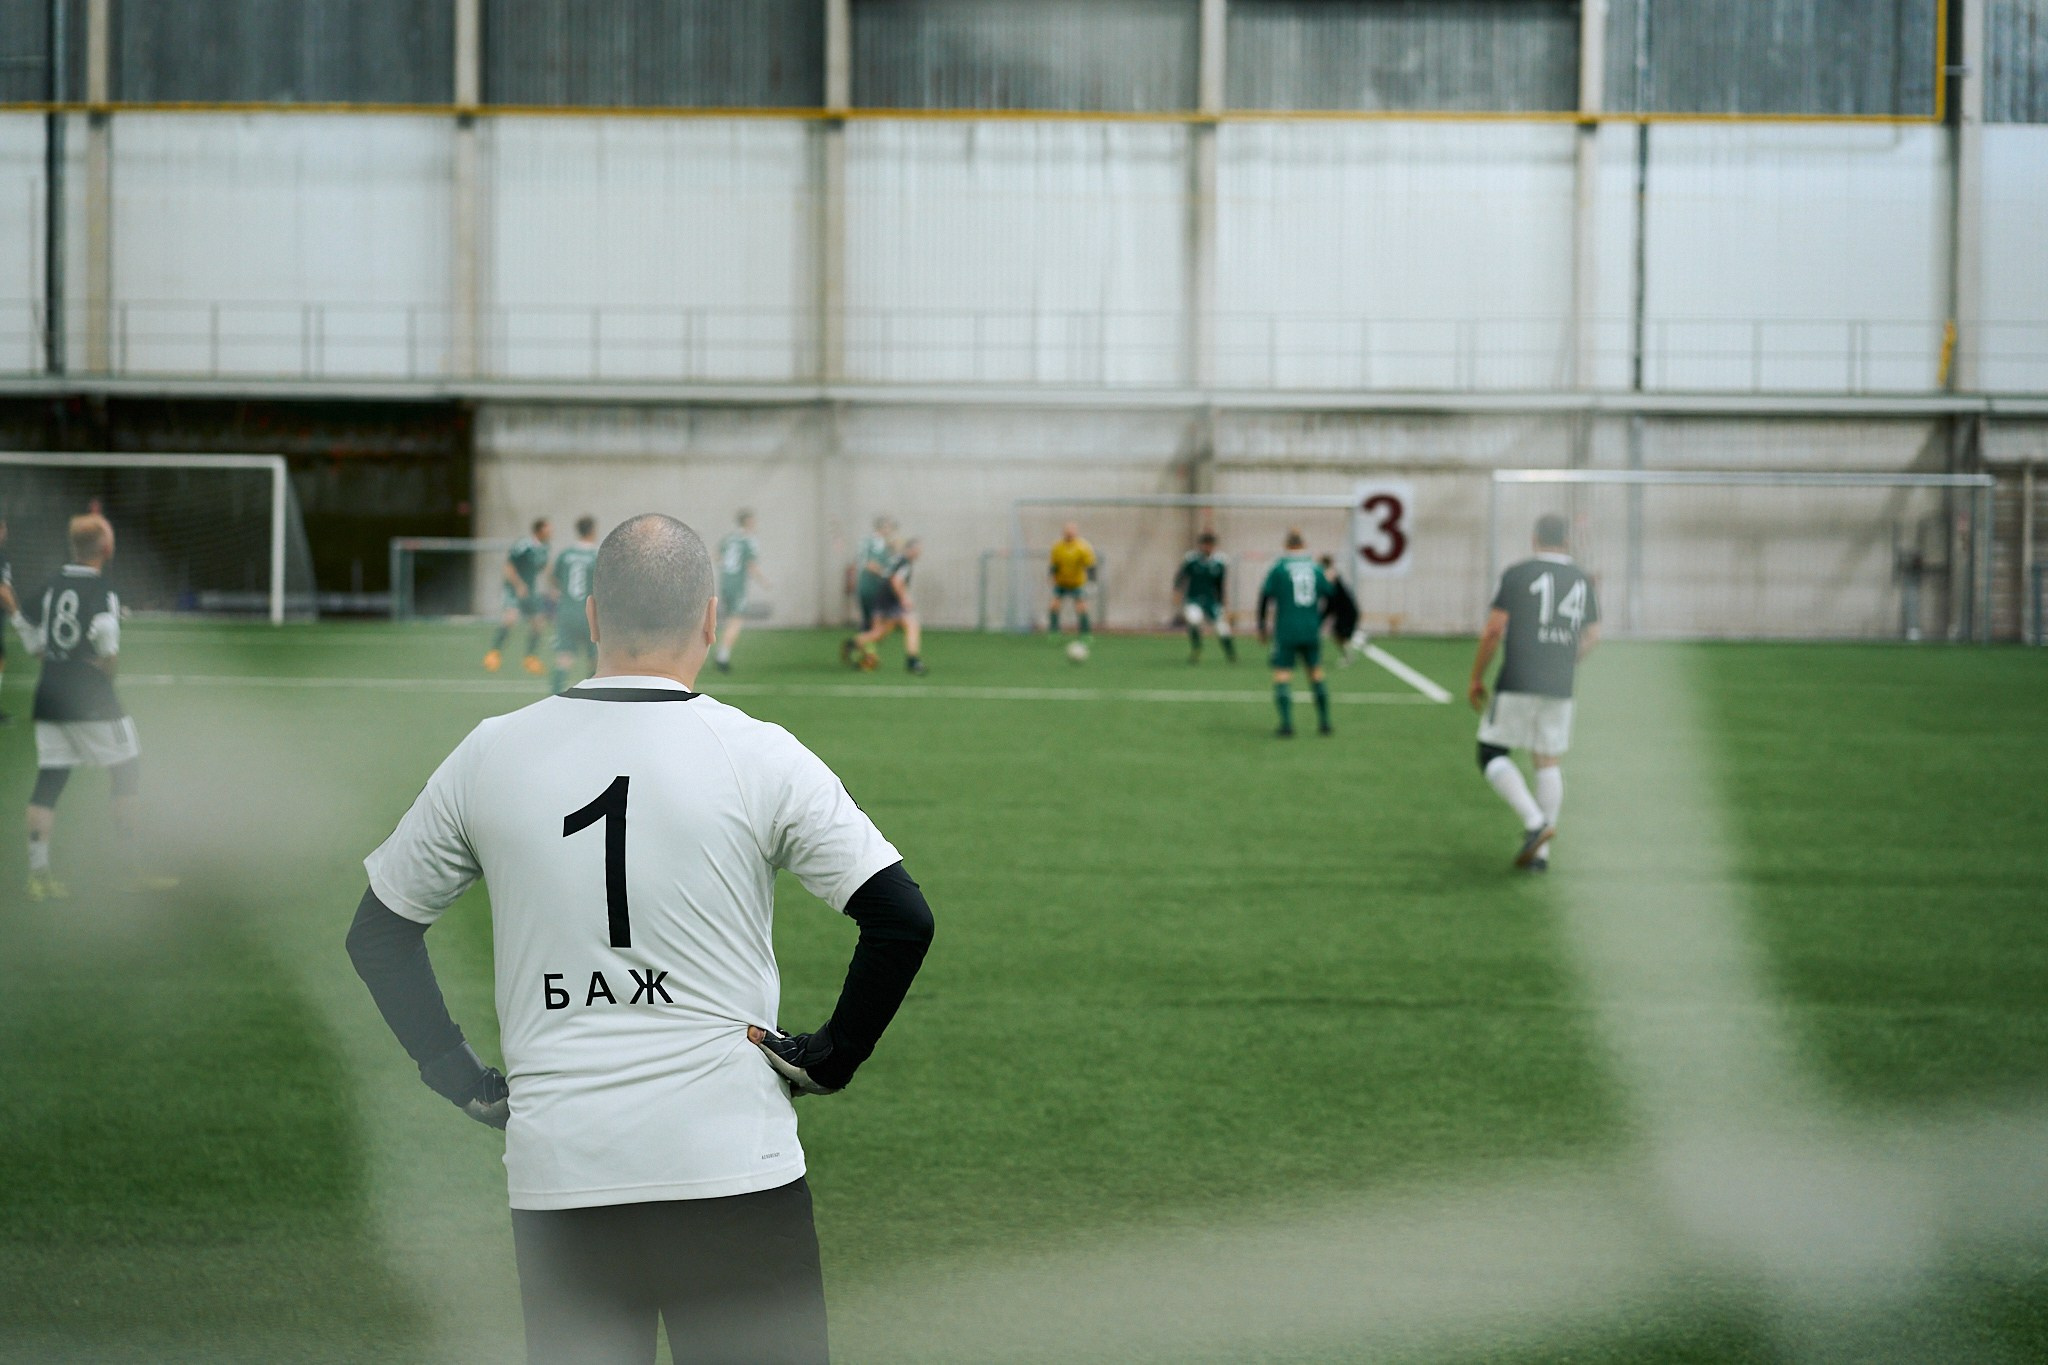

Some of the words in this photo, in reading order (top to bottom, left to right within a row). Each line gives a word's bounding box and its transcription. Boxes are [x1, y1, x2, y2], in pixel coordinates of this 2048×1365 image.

[1360, 493, 1407, 566] 3
[1529, 571, 1587, 631] 14
[562, 775, 631, 949] 1
[543, 969, 674, 1010] БАЖ
